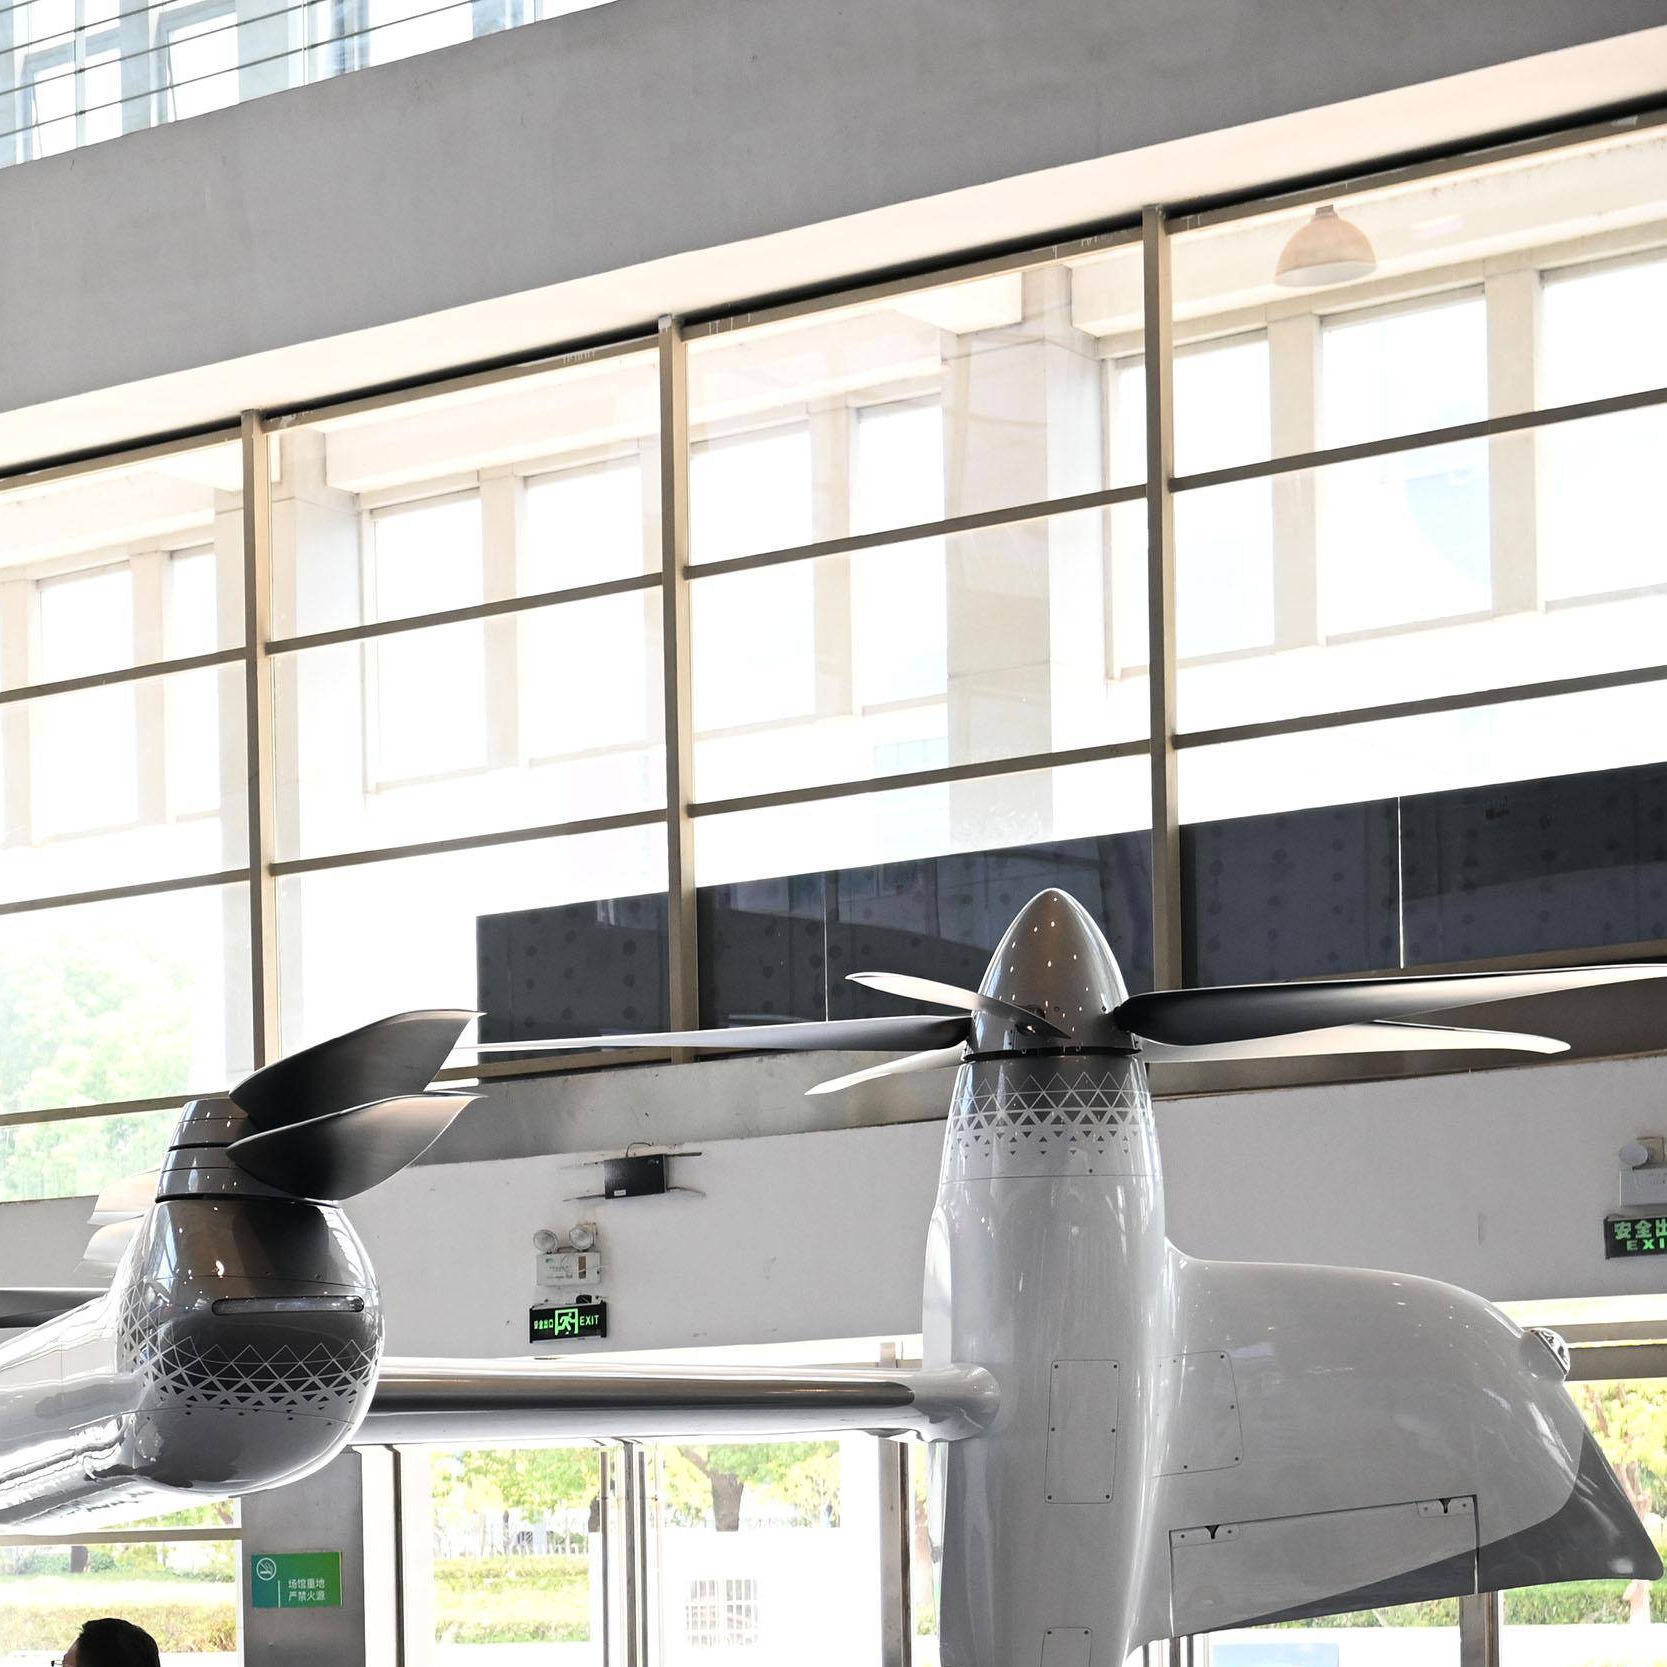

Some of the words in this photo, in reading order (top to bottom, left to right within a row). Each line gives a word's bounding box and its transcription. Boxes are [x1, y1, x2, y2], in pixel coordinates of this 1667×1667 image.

[579, 1315, 600, 1326] EXIT
[288, 1578, 325, 1589] 场馆重地
[288, 1590, 326, 1602] 严禁火源
